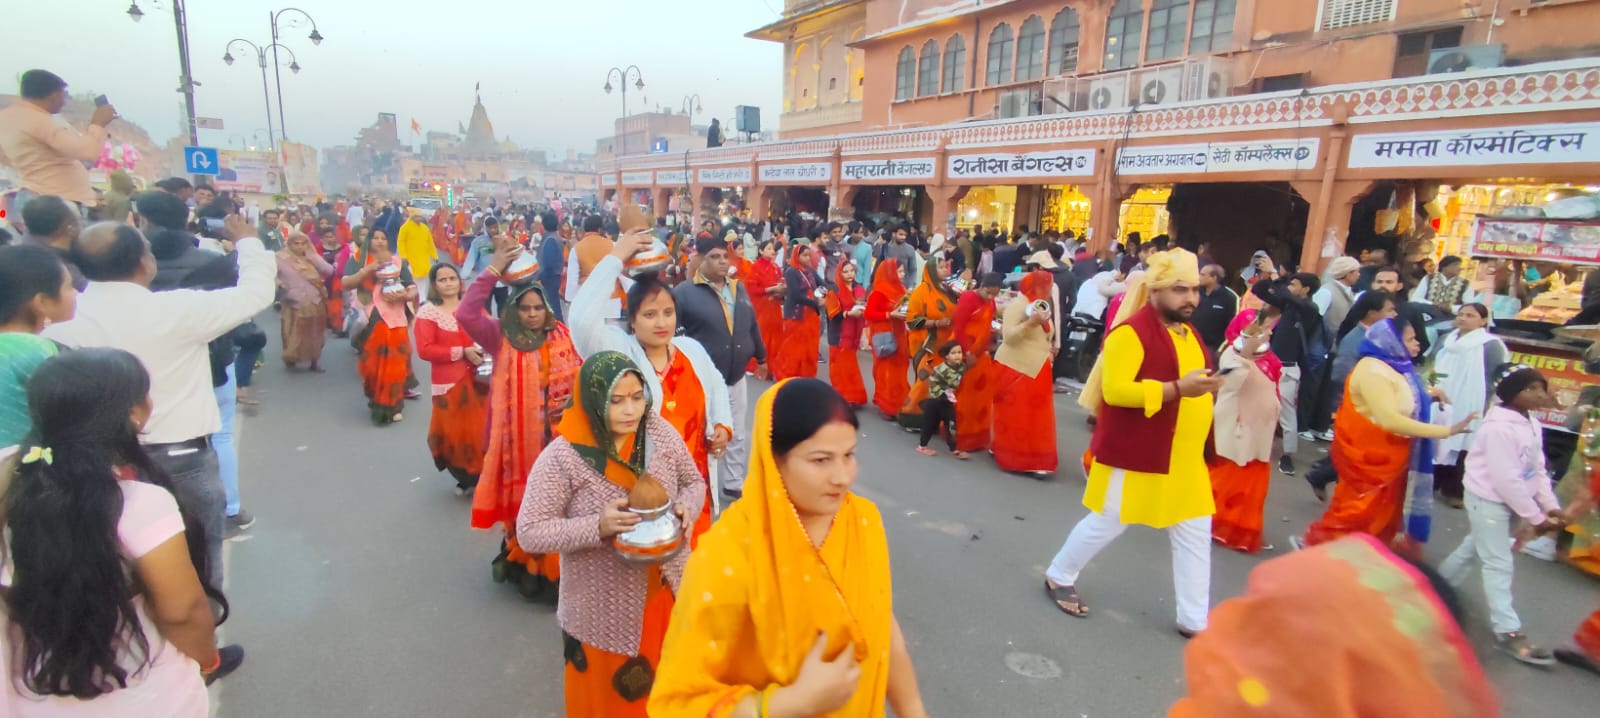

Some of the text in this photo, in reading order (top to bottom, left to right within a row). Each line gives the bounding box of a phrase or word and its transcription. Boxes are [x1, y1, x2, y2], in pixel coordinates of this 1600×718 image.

[1374, 138, 1441, 158] ममता
[844, 159, 896, 179] महारानी
[953, 156, 1009, 175] रानीसा
